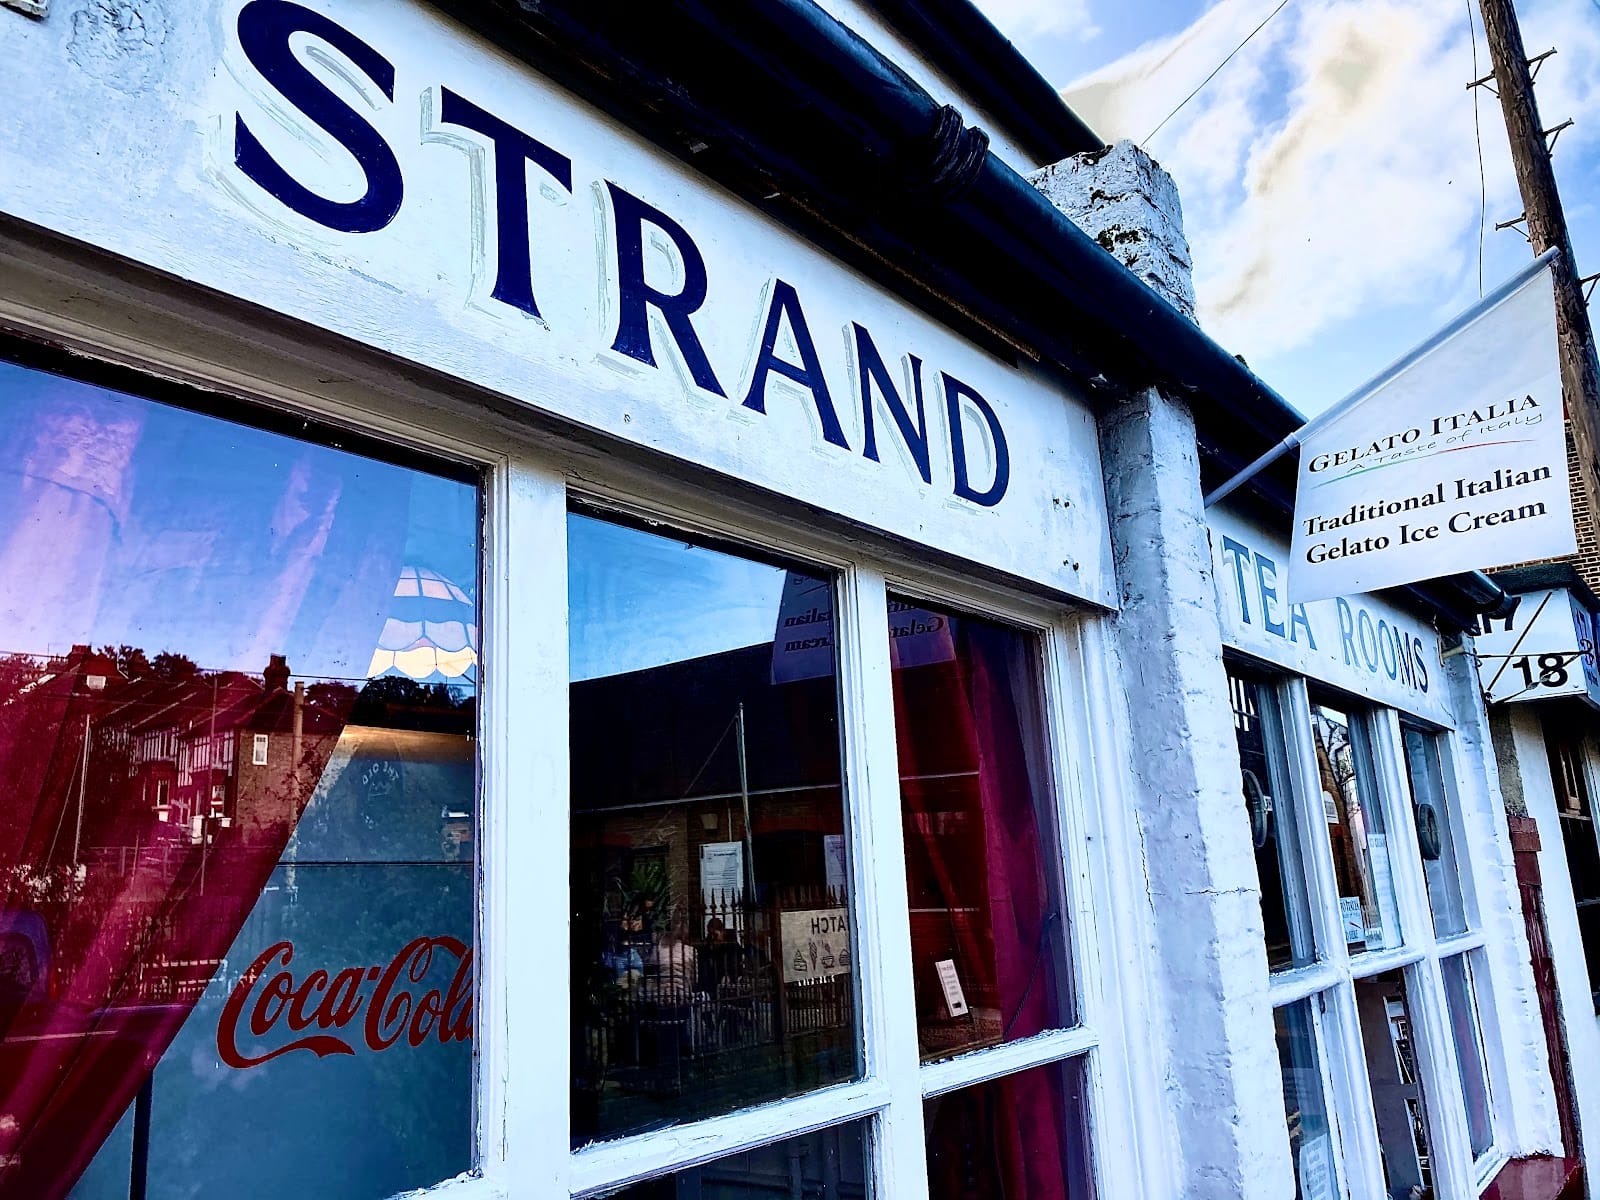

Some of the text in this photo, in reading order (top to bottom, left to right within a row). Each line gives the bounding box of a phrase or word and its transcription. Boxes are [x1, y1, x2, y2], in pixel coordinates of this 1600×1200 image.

[233, 0, 1011, 508] STRAND
[1308, 394, 1541, 473] GELATO ITALIA
[1346, 463, 1366, 473] A
[1370, 440, 1437, 464] Taste
[1446, 429, 1473, 444] of
[1303, 465, 1553, 537] Traditional Italian
[1306, 501, 1548, 564] Gelato Ice Cream
[1222, 534, 1429, 693] TEA ROOMS
[1512, 654, 1568, 688] 18
